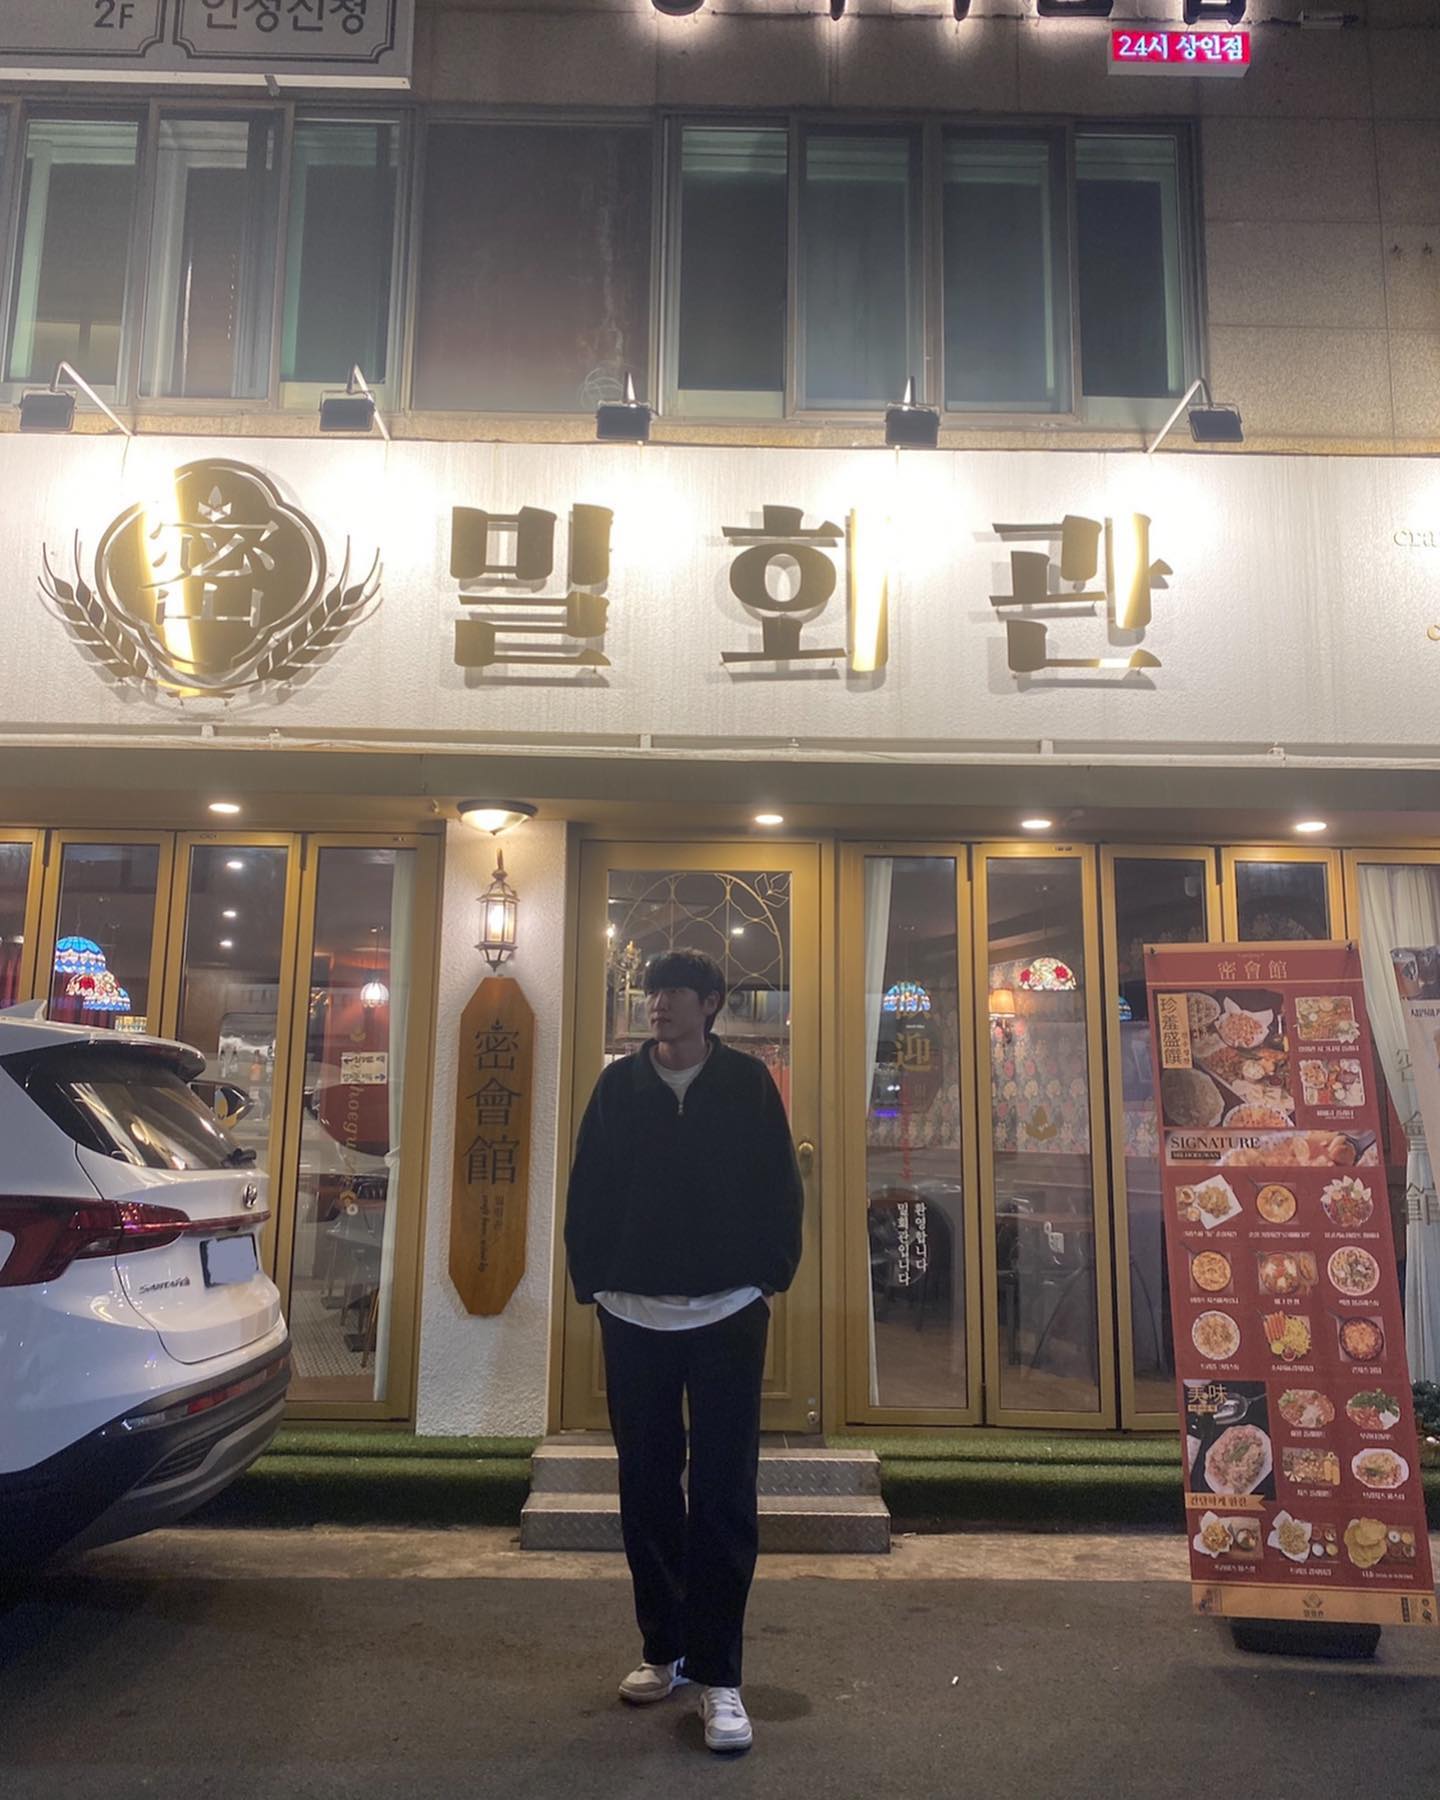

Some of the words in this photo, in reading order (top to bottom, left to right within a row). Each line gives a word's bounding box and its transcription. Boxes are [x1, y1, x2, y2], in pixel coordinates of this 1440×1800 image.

[94, 0, 135, 29] 2F
[1118, 33, 1168, 60] 24시
[1175, 34, 1243, 61] 상인점
[451, 503, 1173, 673] 밀회관
[463, 1018, 522, 1185] 密會館
[1170, 1136, 1261, 1149] SIGNATURE
[915, 1202, 928, 1273] 환영합니다
